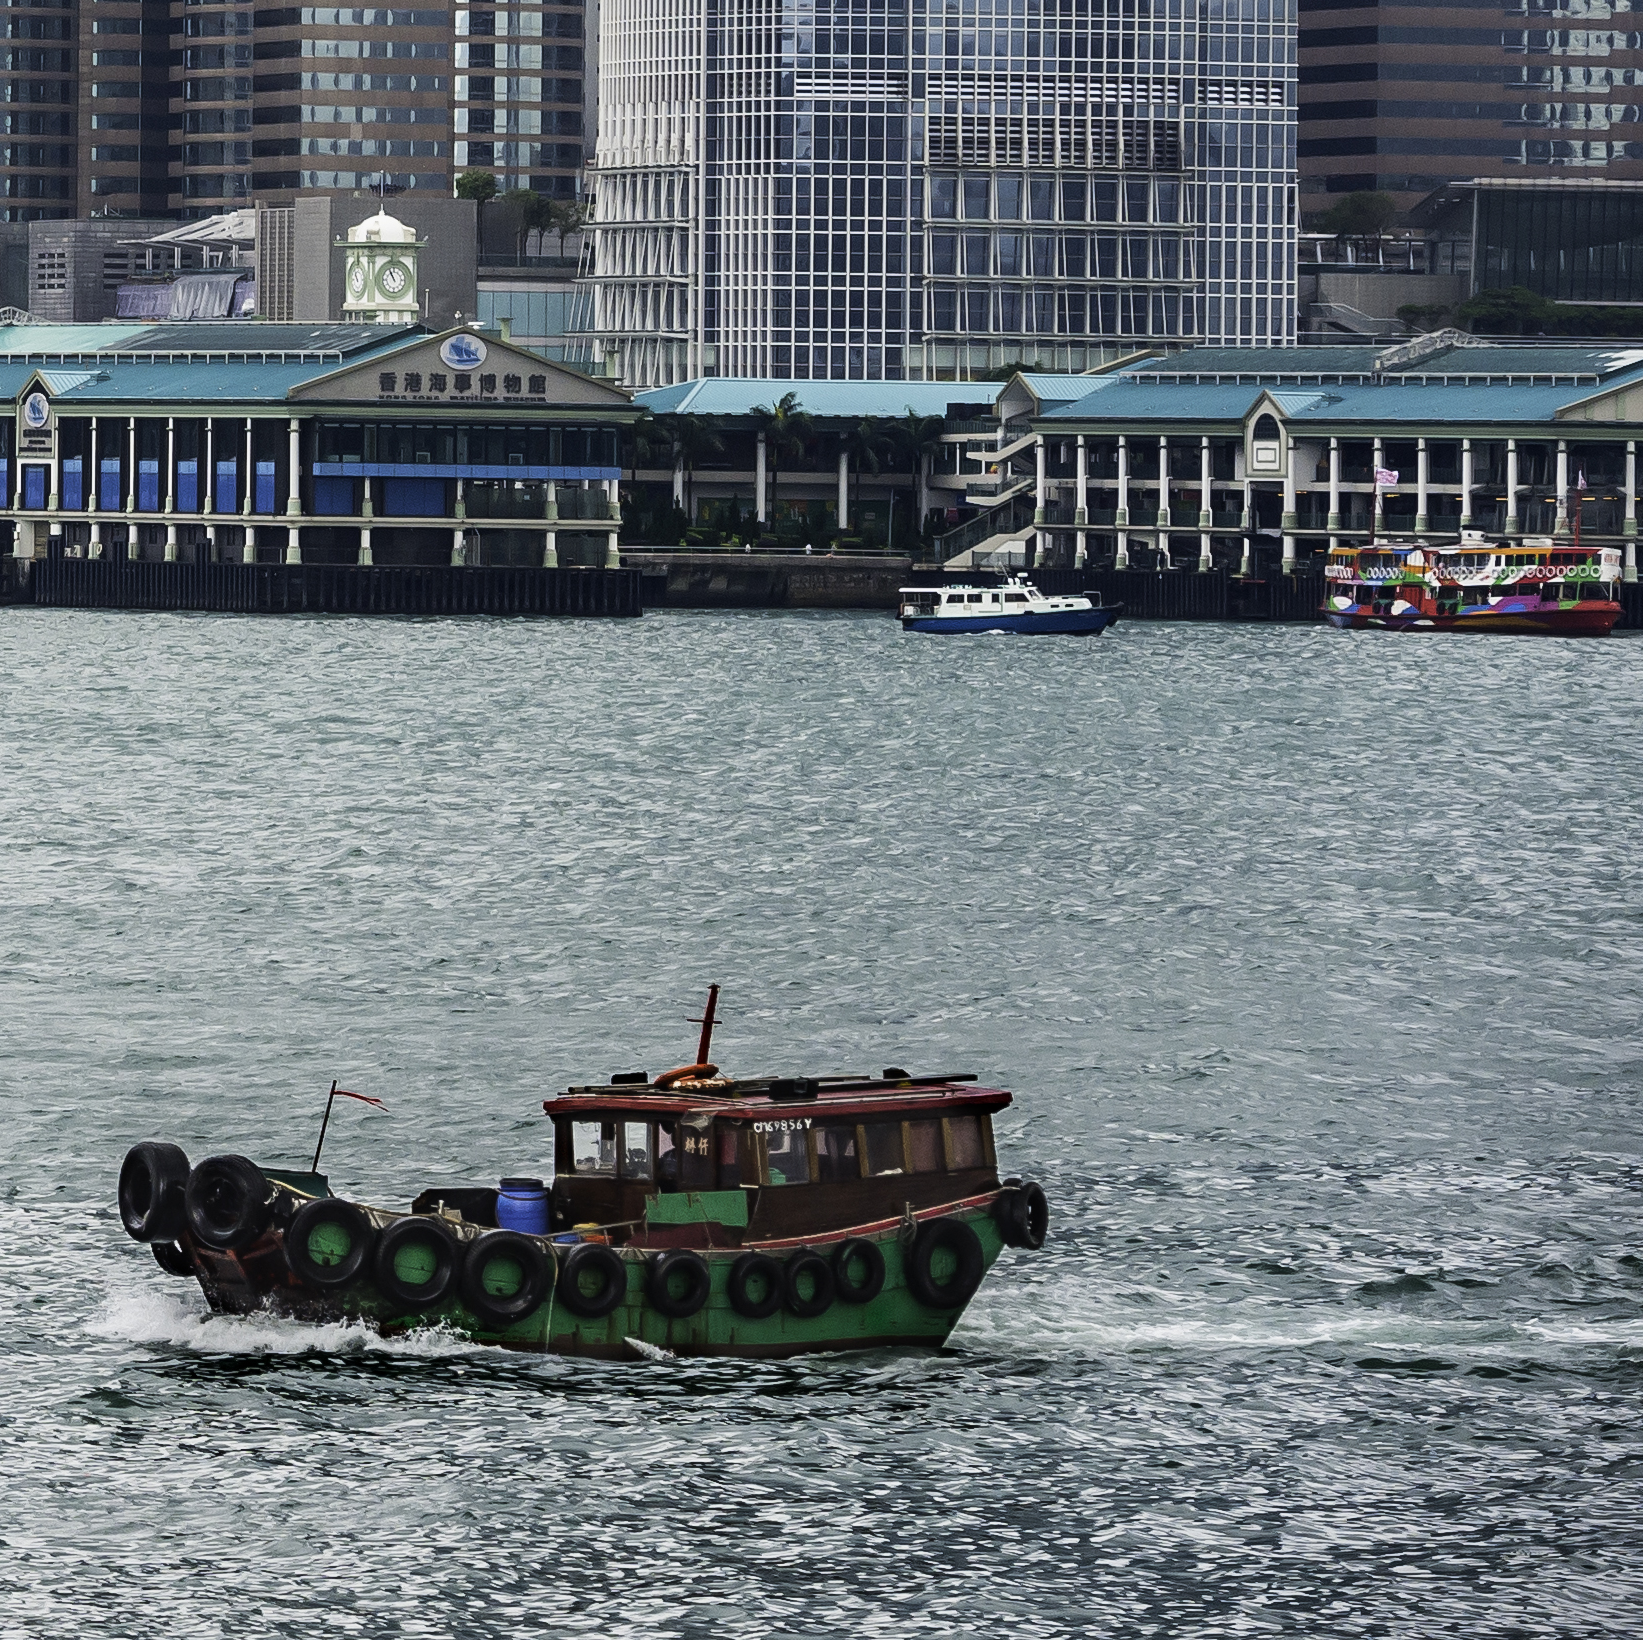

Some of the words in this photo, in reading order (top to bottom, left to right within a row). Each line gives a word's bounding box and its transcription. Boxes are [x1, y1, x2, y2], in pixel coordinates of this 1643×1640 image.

[379, 372, 547, 394] 香港海事博物館
